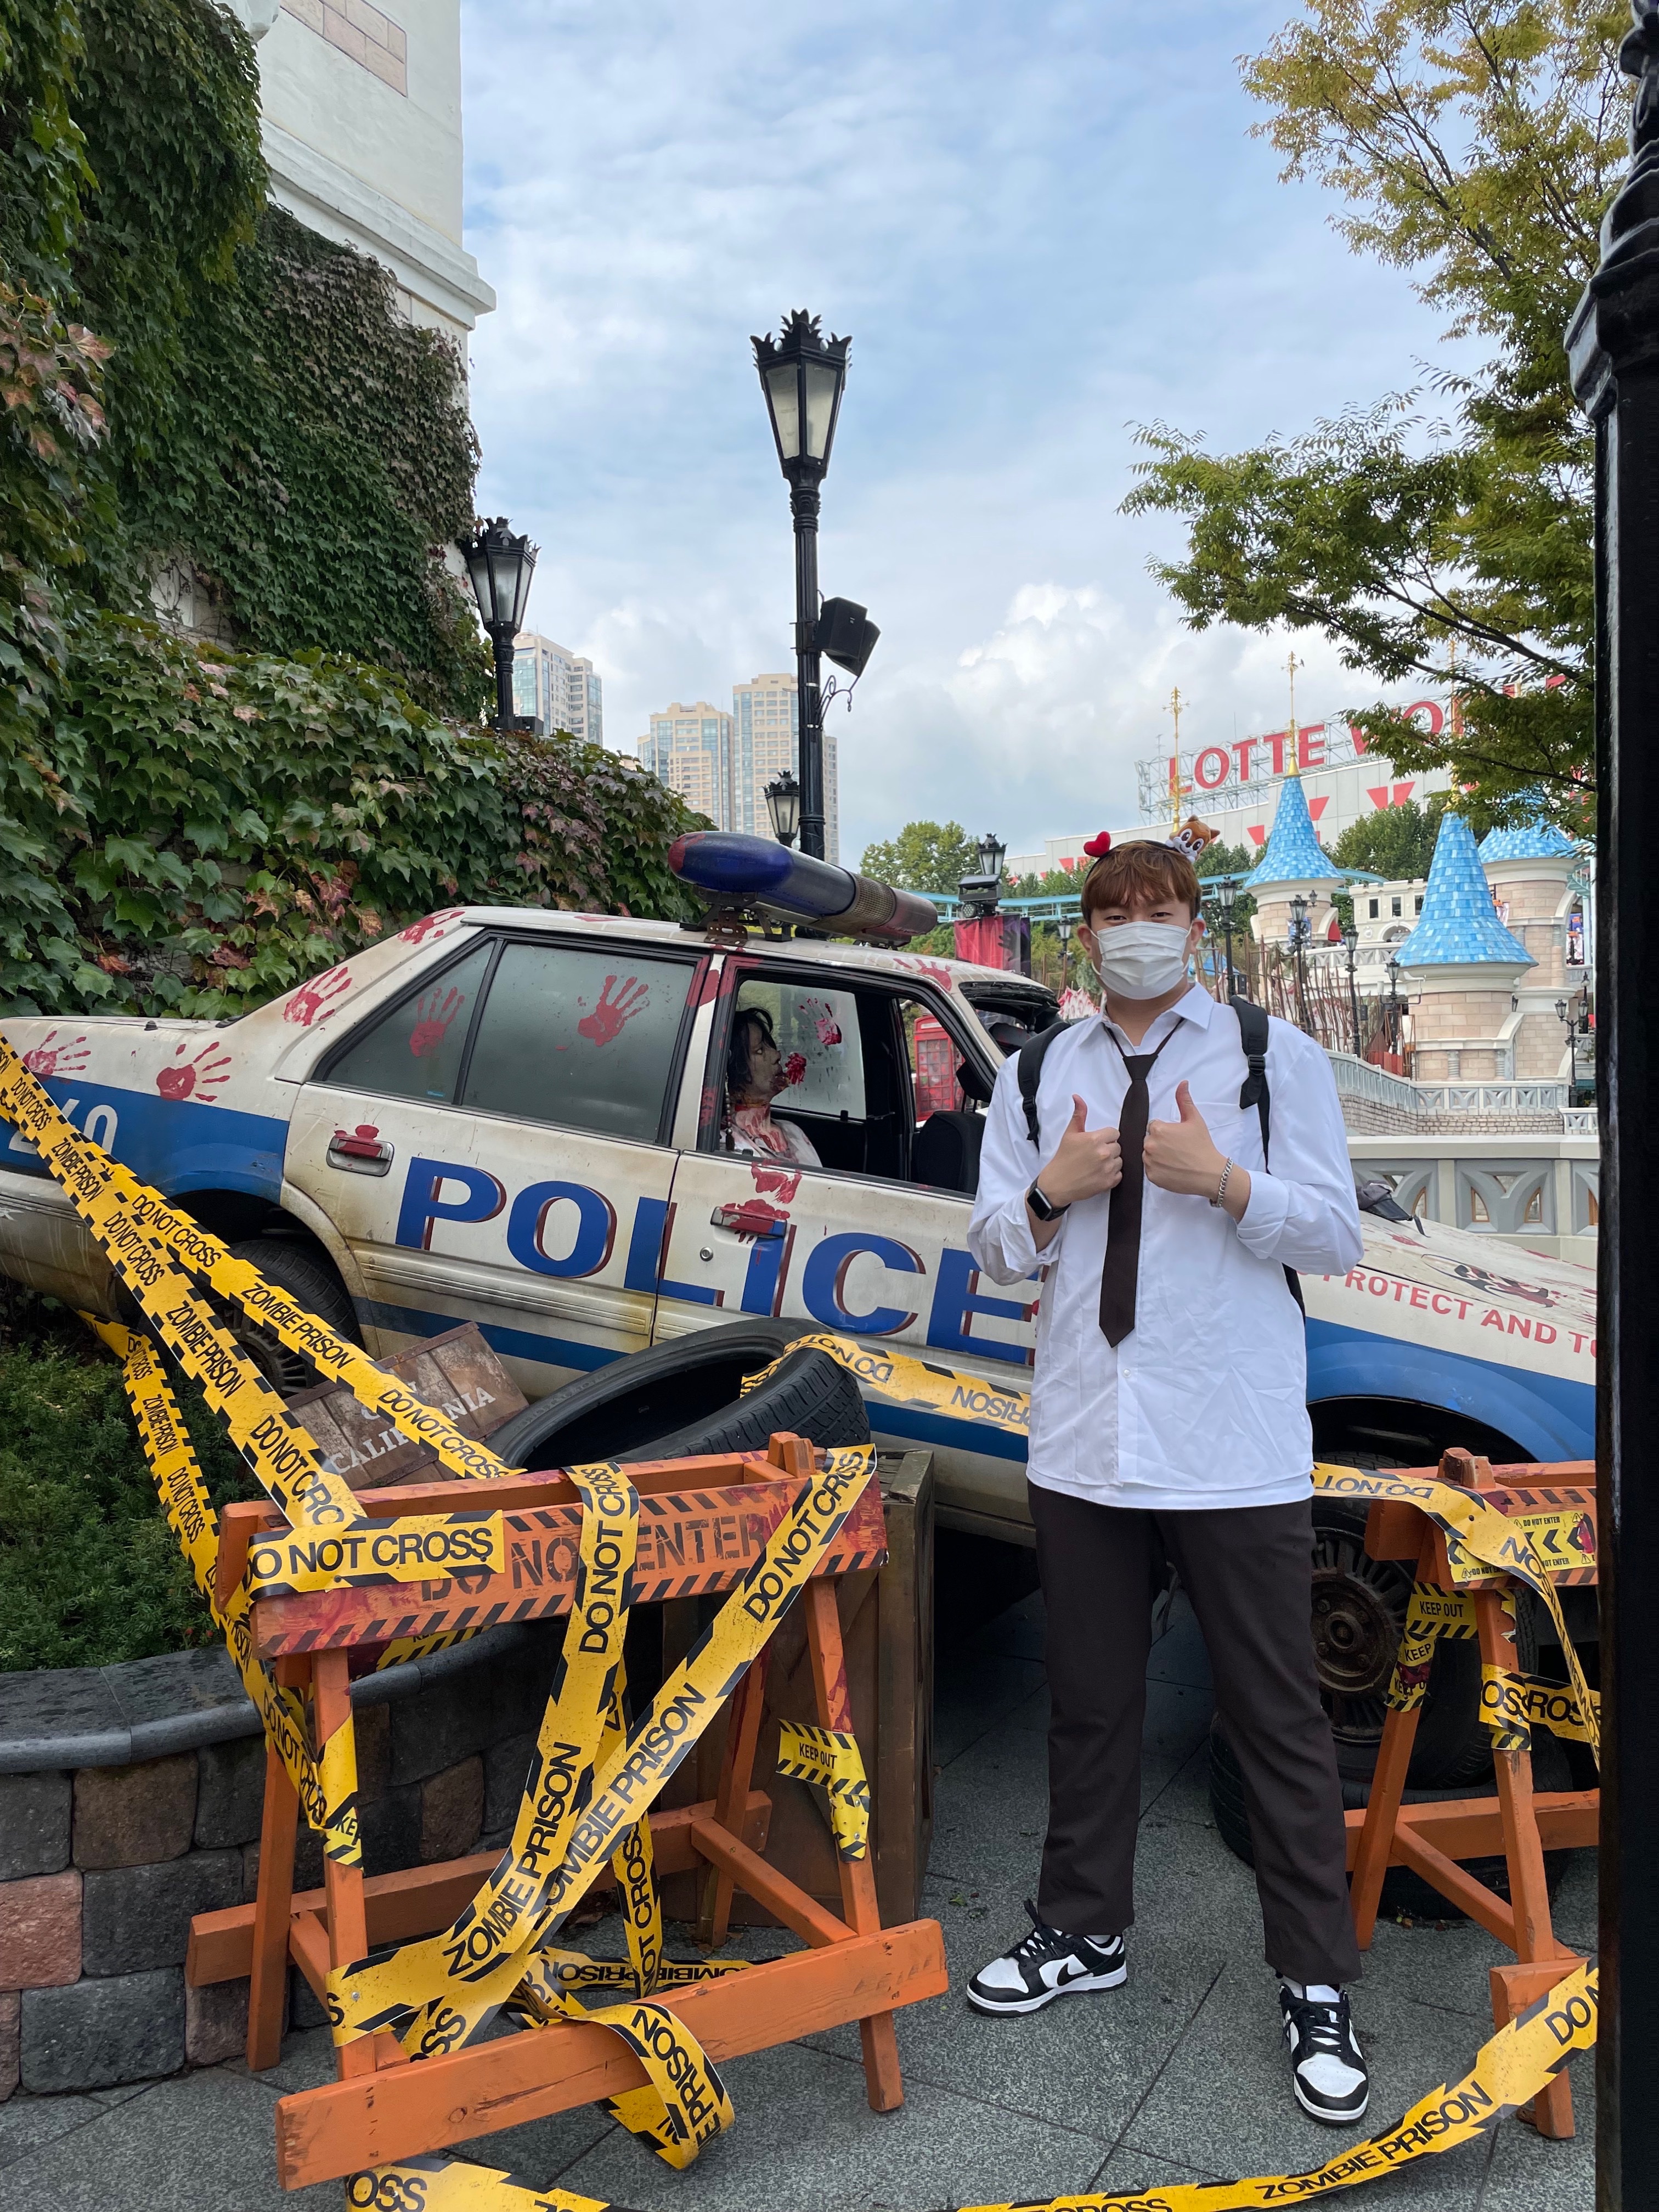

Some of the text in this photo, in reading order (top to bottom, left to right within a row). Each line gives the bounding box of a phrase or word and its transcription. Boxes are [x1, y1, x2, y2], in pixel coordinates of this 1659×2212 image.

[1169, 724, 1325, 794] LOTTE
[10, 1076, 52, 1131] DO NOT CROSS
[51, 1137, 105, 1202] ZOMBIE PRISON
[103, 1211, 127, 1233] DO
[112, 1224, 143, 1252] NOT
[132, 1194, 222, 1267] DO NOT CROSS
[127, 1245, 165, 1286] CROSS
[396, 1156, 1049, 1366] POLICE
[241, 1282, 356, 1369] ZOMBIE PRISON
[1323, 1269, 1596, 1358] ROTECT AND T
[166, 1300, 246, 1398] ZOMBIE PRISON
[802, 1336, 855, 1363] NOT
[854, 1357, 895, 1384] DO
[142, 1394, 179, 1457] ZOMBIE PRISON
[250, 1414, 283, 1450] DO
[377, 1389, 414, 1412] DO
[408, 1409, 453, 1438] NOT
[441, 1436, 509, 1479] CROSS
[266, 1437, 309, 1482] NOT
[1315, 1475, 1435, 1499] DO NOT
[167, 1466, 205, 1544] DO NOT CROSS
[580, 1468, 625, 1516] CROSS
[242, 1548, 283, 1590] DO
[289, 1537, 366, 1575] NOT
[372, 1528, 493, 1567] CROSS
[590, 1520, 623, 1595] NOT
[742, 1572, 784, 1624] DO
[773, 1509, 821, 1578] NOT
[579, 1601, 613, 1654] DO
[1419, 1601, 1464, 1617] KEEP OUT
[1404, 1643, 1431, 1661] KEEP
[264, 1690, 276, 1733] DO
[277, 1714, 300, 1769] NOT
[612, 1683, 707, 1804] PRISON
[799, 1742, 838, 1769] KEEP OUT
[441, 1877, 535, 1977] ZOMBIE
[518, 1741, 582, 1880] PRISON
[631, 2009, 714, 2128] PRISON
[1255, 2149, 1384, 2200] ZOMBIE
[1377, 2081, 1493, 2160] PRISON
[1544, 1996, 1591, 2046] DO
